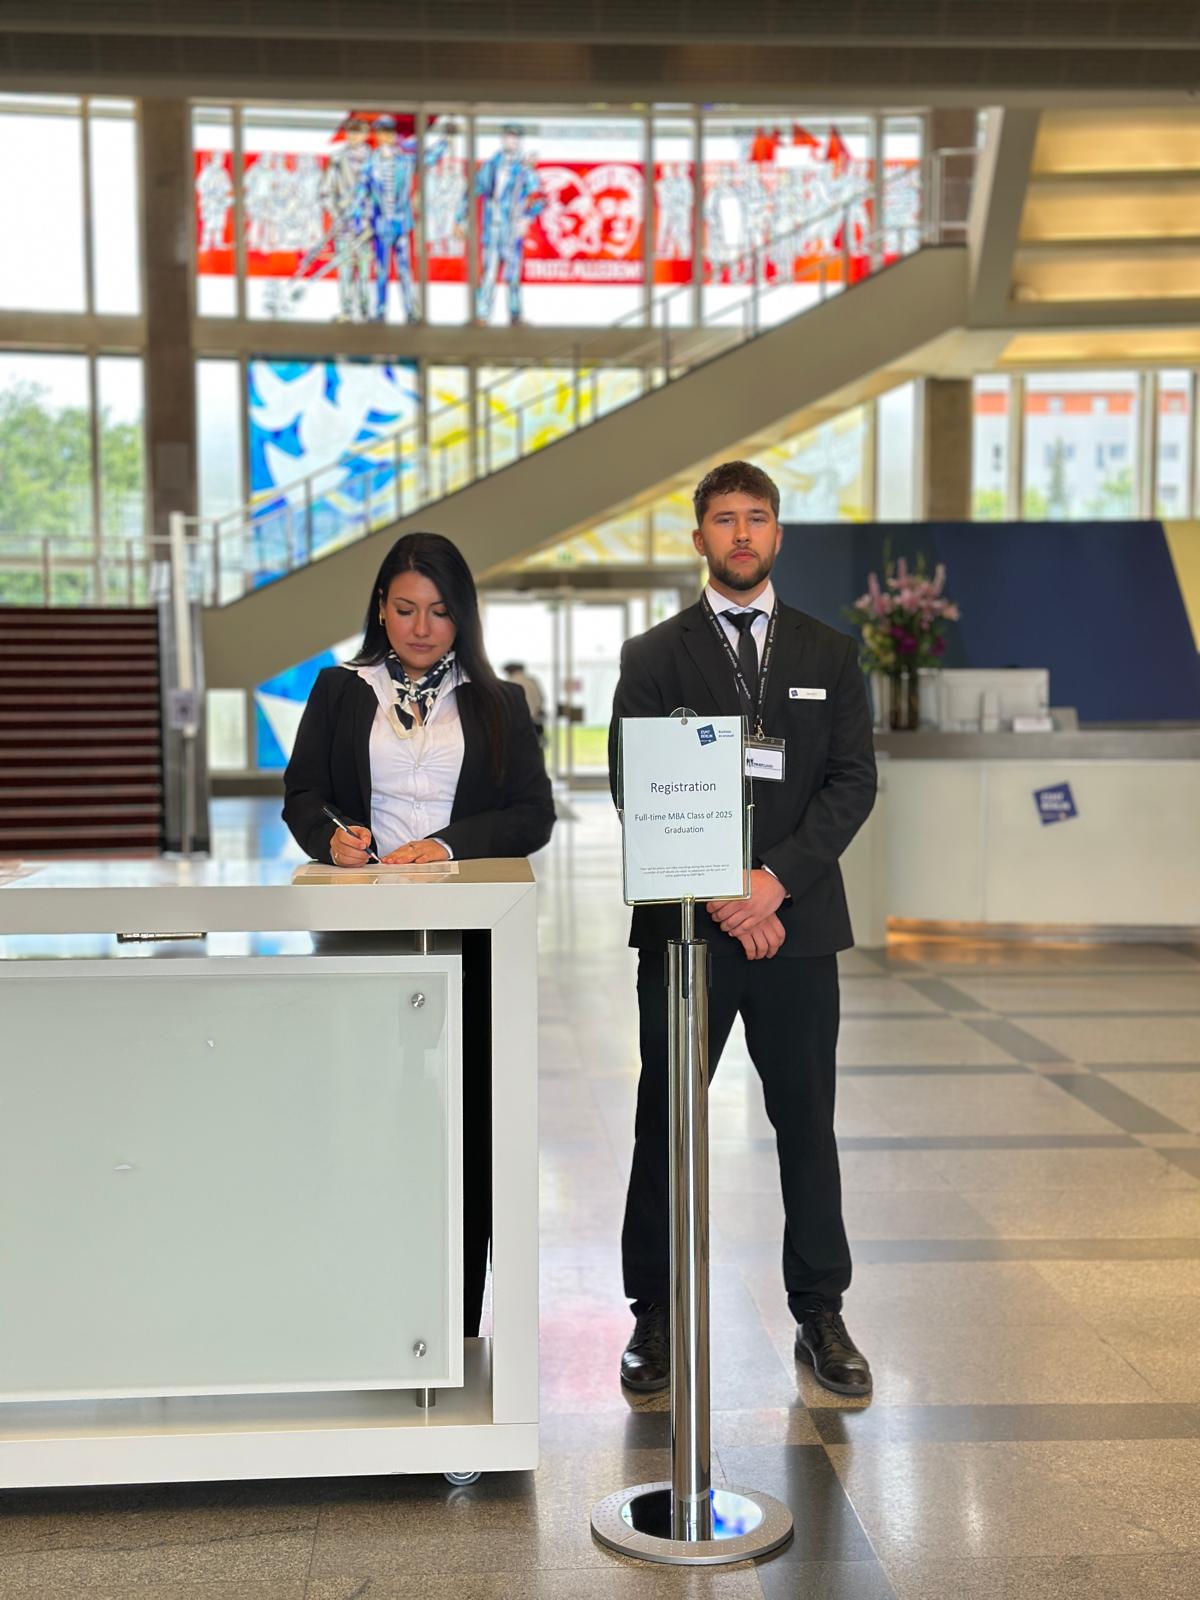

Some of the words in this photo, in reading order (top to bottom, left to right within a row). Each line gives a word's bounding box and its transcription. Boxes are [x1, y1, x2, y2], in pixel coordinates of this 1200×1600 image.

[650, 781, 717, 795] Registration
[634, 812, 666, 821] Full-time
[667, 812, 685, 820] MBA
[687, 811, 705, 820] Class
[706, 811, 714, 819] of
[715, 810, 733, 819] 2025
[664, 826, 704, 834] Graduation
